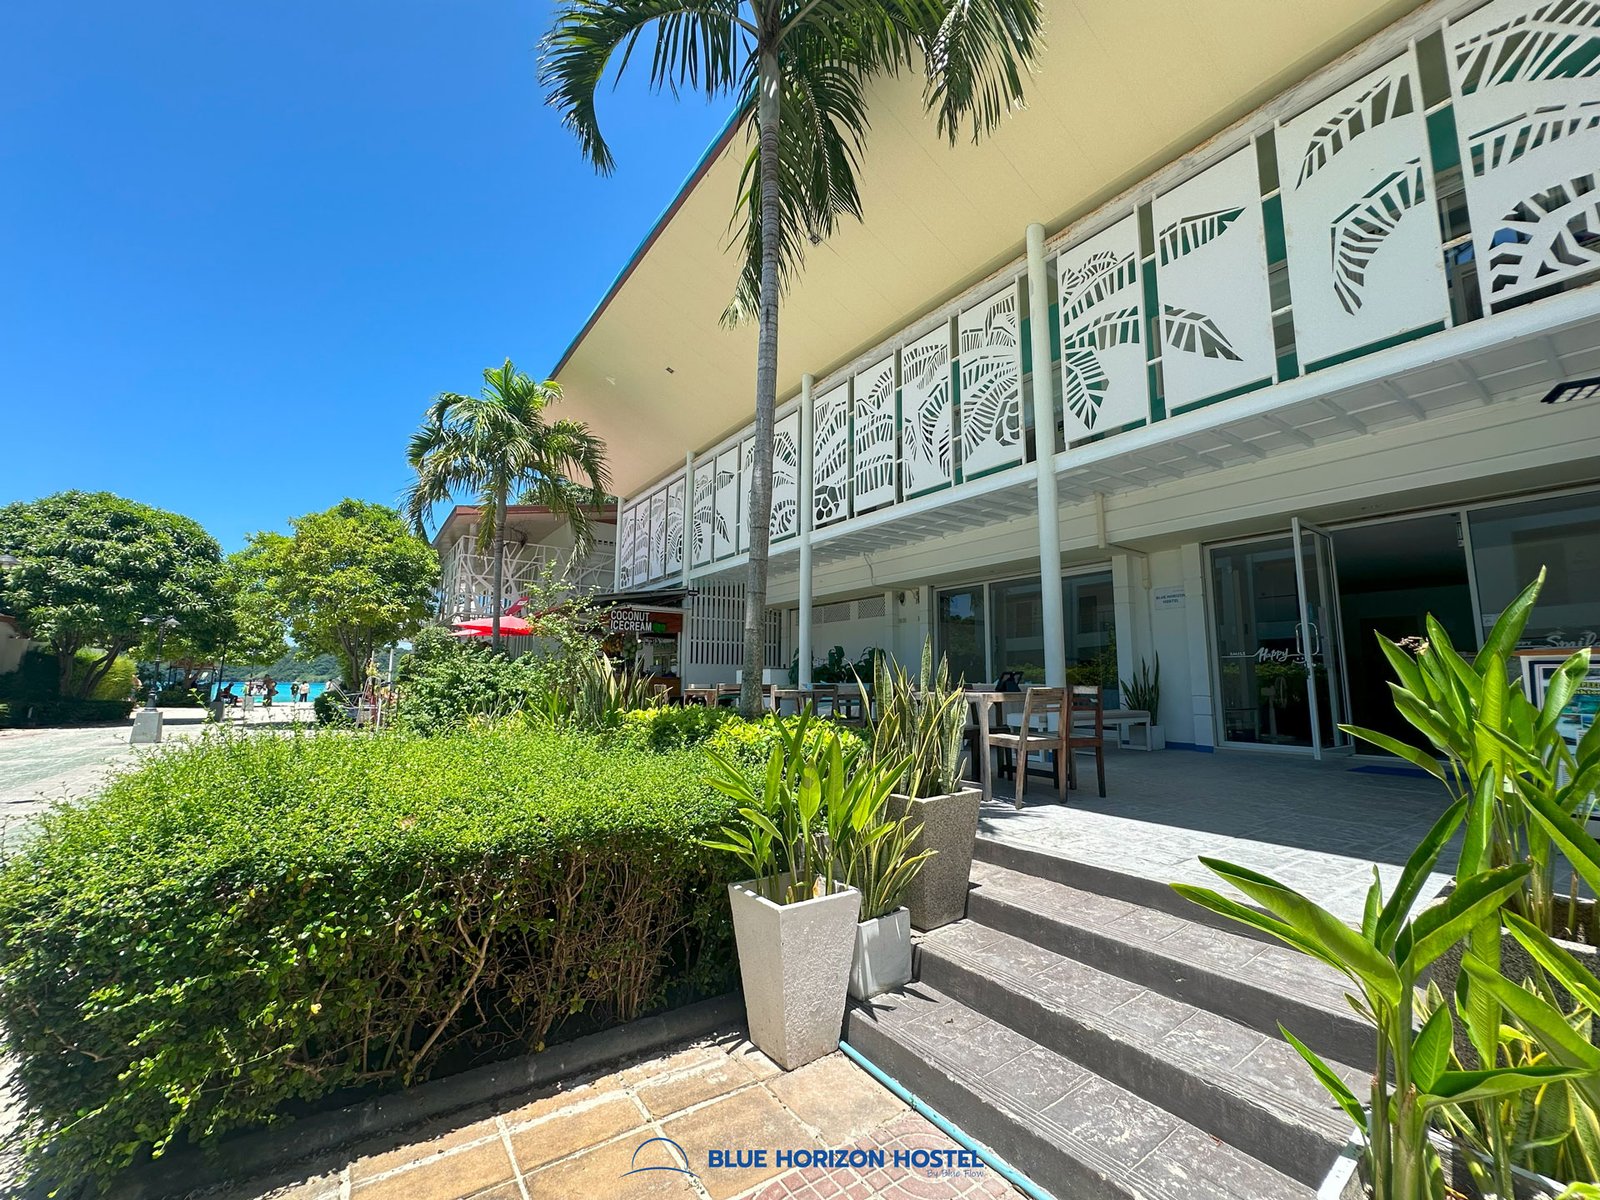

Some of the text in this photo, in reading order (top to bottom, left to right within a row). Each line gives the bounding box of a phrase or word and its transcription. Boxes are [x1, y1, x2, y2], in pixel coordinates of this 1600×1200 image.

[610, 610, 650, 622] COCONUT
[610, 619, 652, 632] ICECREAM
[1256, 646, 1289, 663] Happy
